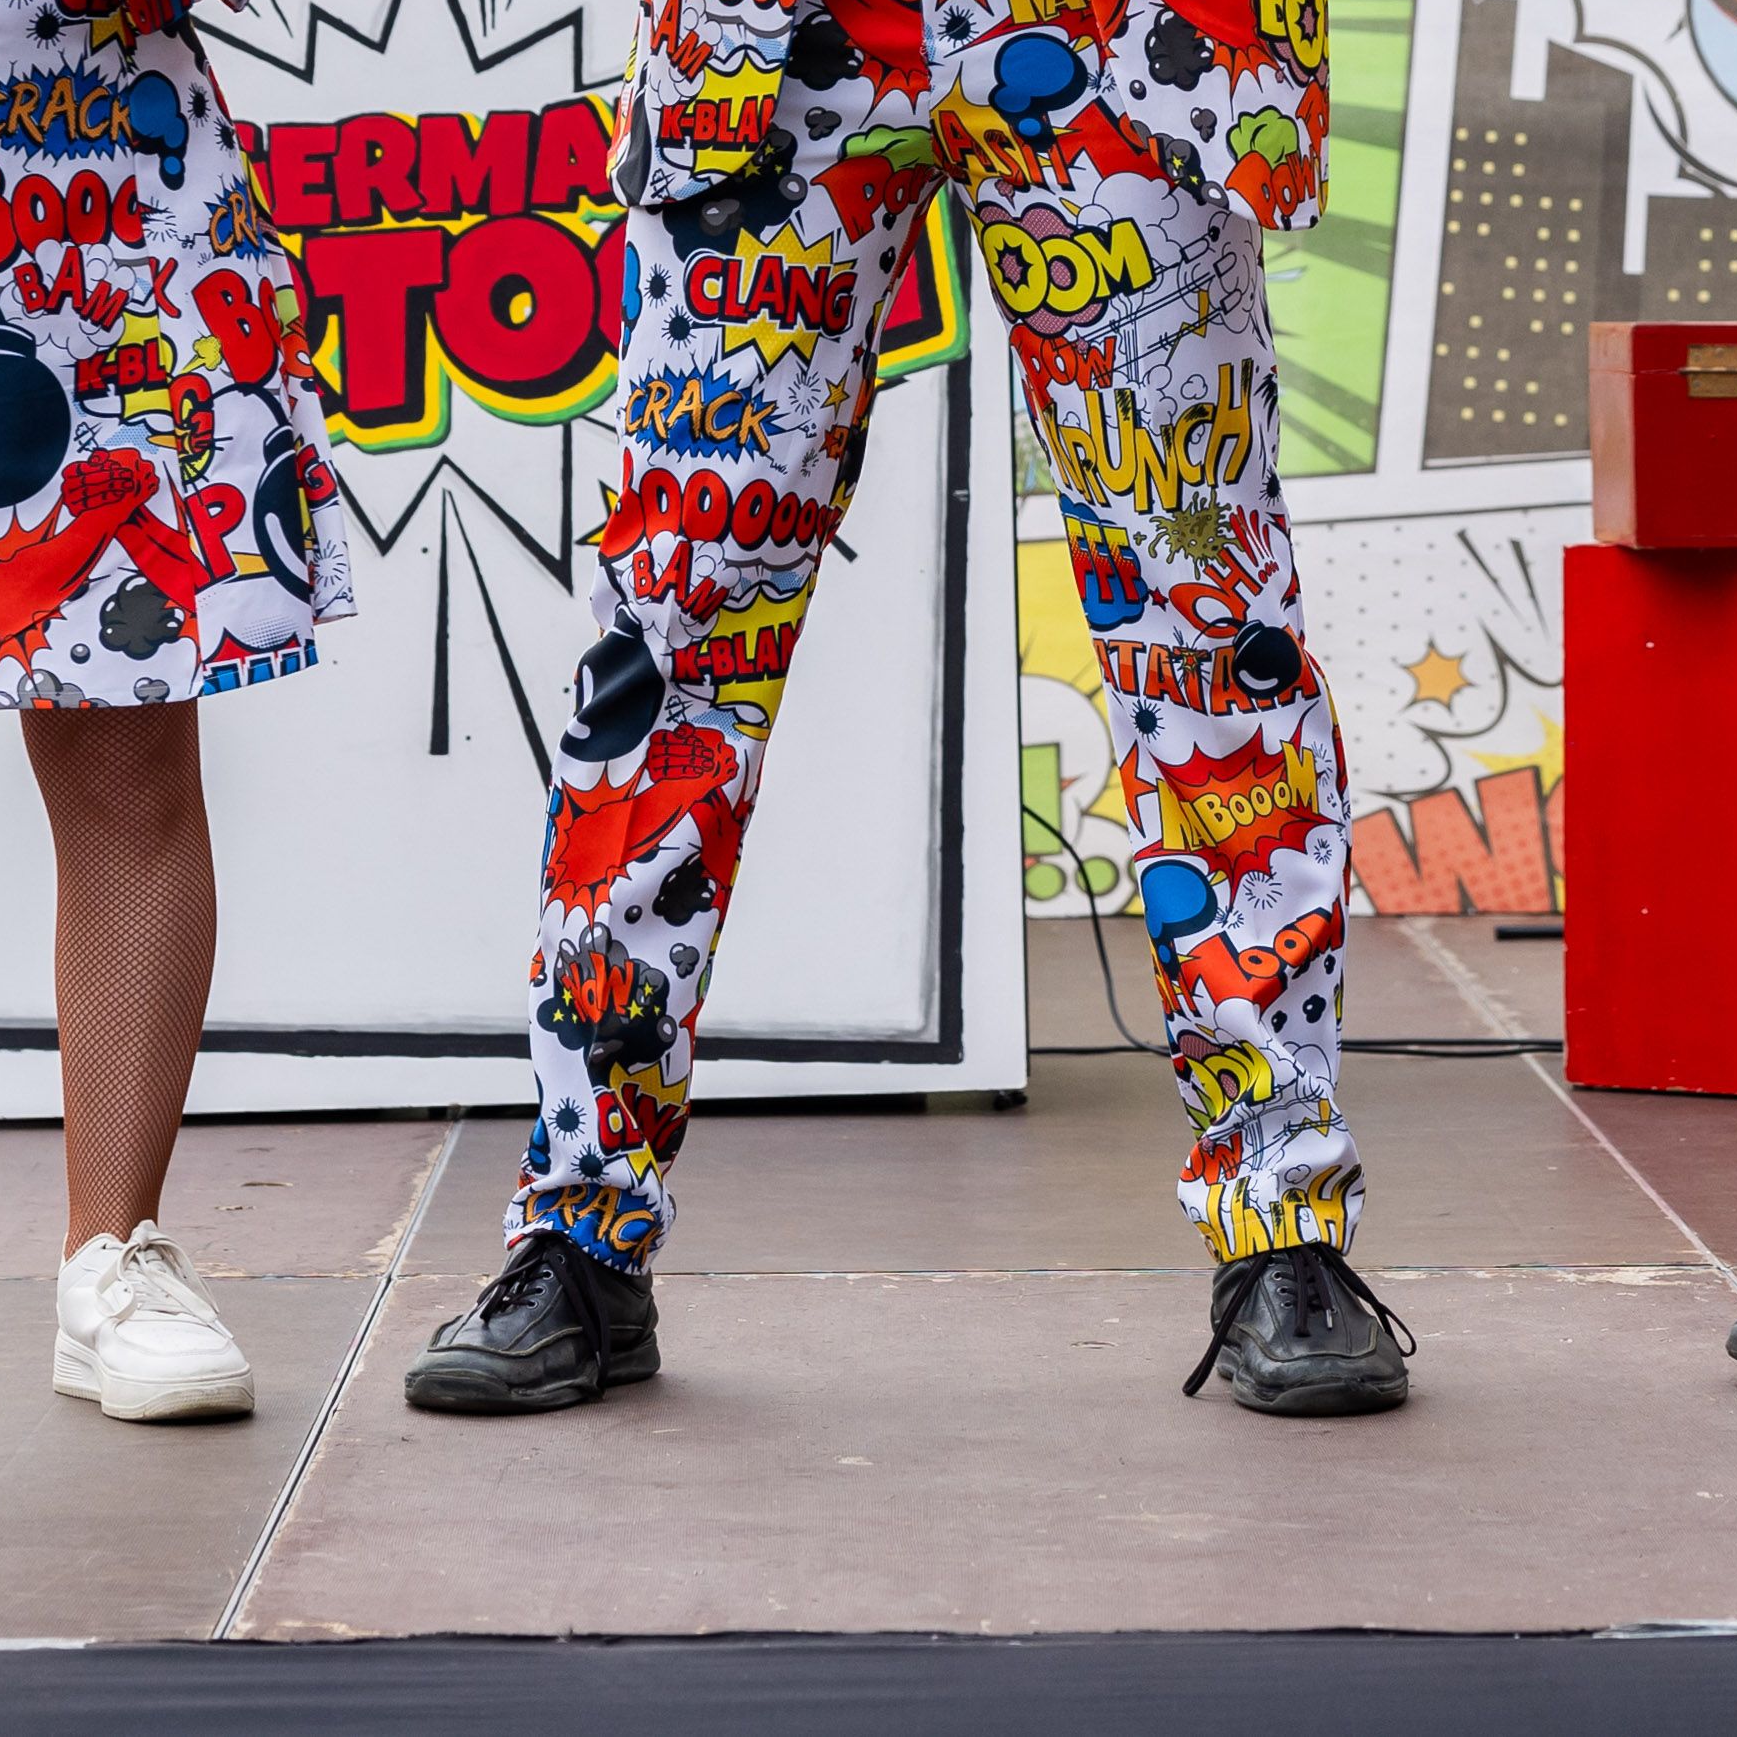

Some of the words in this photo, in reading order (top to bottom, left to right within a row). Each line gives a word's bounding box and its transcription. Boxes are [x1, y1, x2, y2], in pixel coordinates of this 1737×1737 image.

[12, 246, 130, 333] BAM
[689, 255, 855, 334] CLANG
[624, 378, 778, 453] CRACK
[631, 542, 729, 624] BAM
